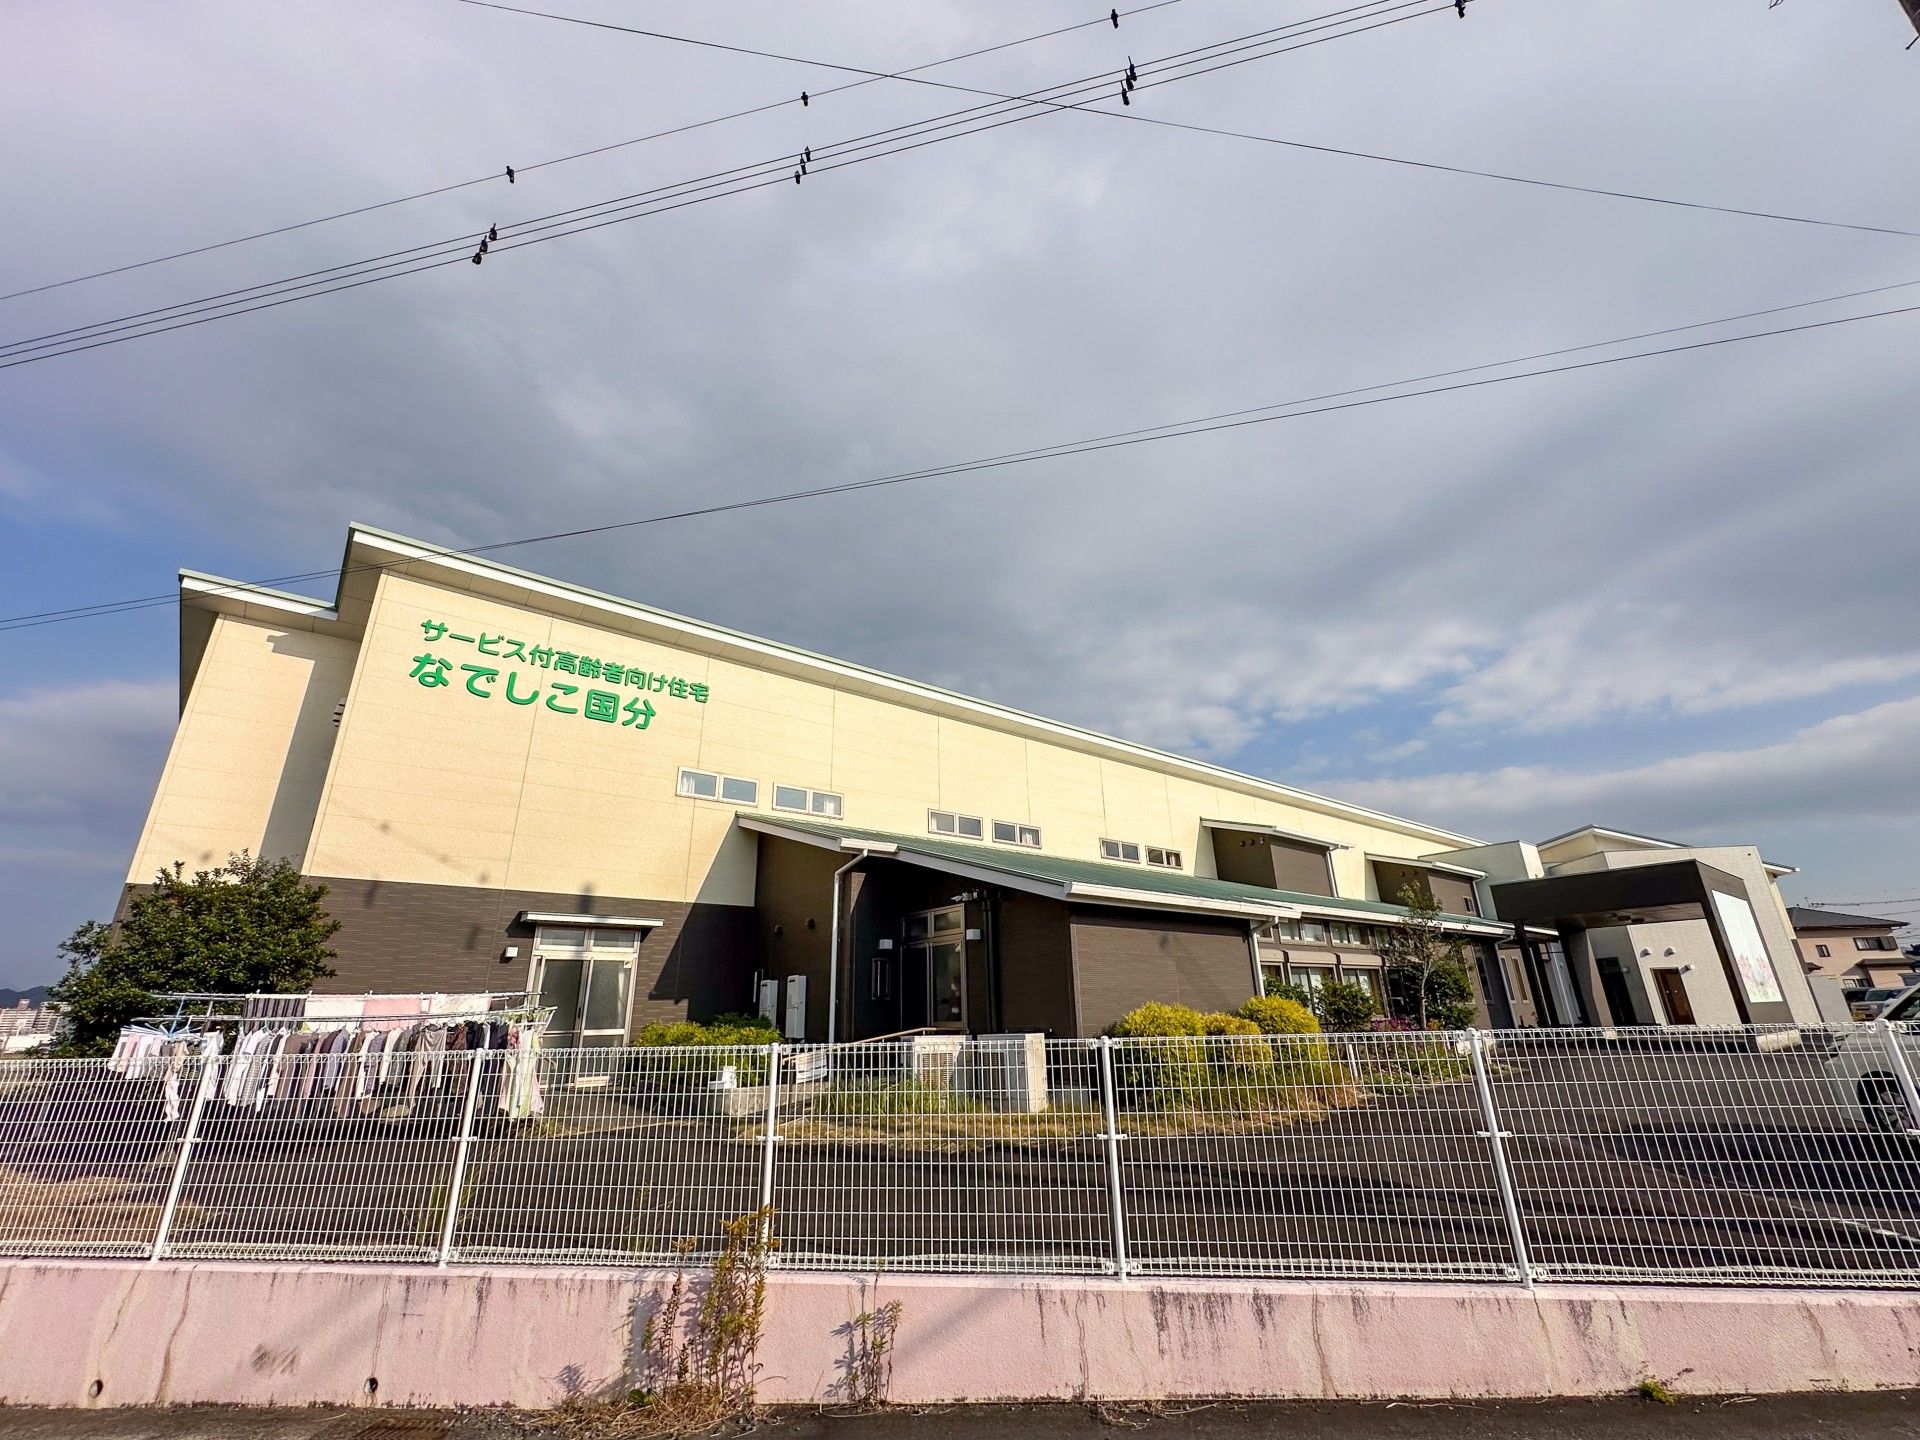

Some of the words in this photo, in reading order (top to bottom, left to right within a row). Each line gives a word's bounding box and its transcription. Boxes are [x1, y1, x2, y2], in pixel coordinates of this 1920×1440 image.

[409, 652, 656, 730] なでしこ国分
[421, 619, 710, 703] サービス付高齢者向け住宅
